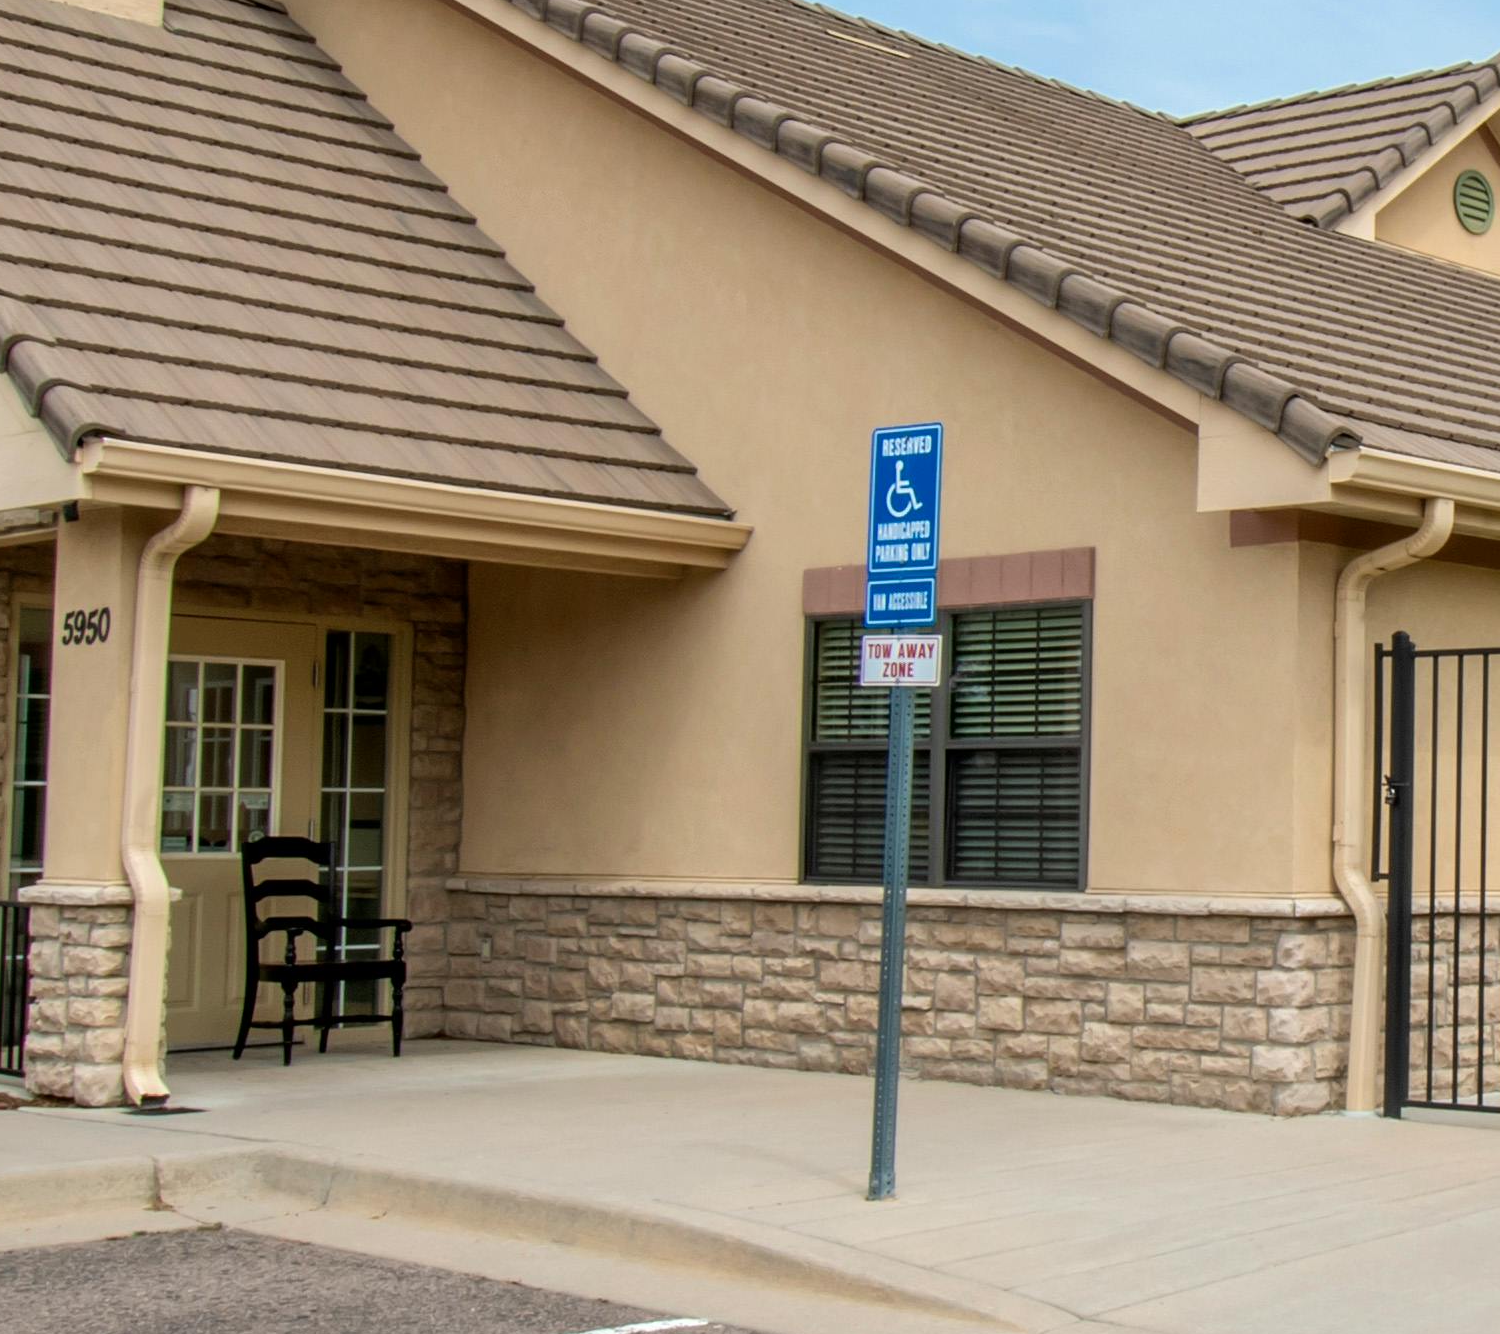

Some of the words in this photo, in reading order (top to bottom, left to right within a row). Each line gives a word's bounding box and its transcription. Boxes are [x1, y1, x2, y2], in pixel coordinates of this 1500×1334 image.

[882, 435, 932, 457] RESERVED
[877, 520, 931, 541] HANDICAPPED
[875, 544, 909, 563] PARKING
[911, 543, 931, 561] ONLY
[888, 590, 928, 611] ACCESSIBLE
[62, 607, 111, 645] 5950
[868, 644, 891, 659] TOW
[897, 643, 935, 658] AWAY
[883, 662, 914, 678] ZONE
